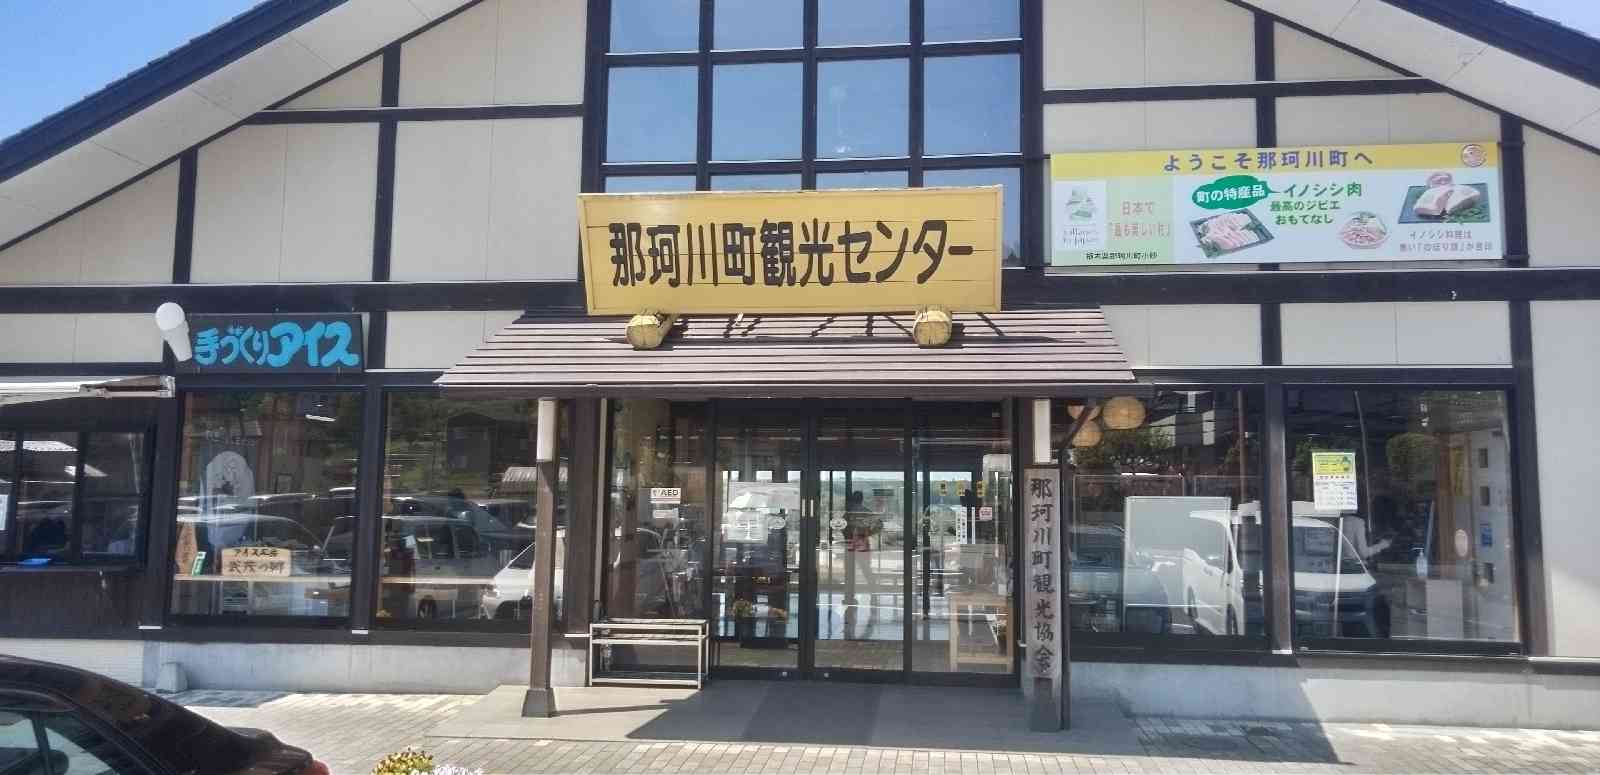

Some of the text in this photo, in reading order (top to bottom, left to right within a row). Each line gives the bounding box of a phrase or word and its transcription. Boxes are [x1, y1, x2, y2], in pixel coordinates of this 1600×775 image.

[1164, 150, 1373, 171] ようこそ那珂川町へ
[1196, 184, 1265, 203] 町の特産品
[1283, 182, 1362, 197] イノシシ肉
[1122, 201, 1156, 216] 日本で
[1270, 200, 1341, 212] 最高のジビエ
[1275, 214, 1333, 225] おもてなし
[608, 218, 973, 288] 那珂川町観光センター
[194, 320, 360, 368] 手づくりアイス
[1030, 477, 1055, 674] 那珂川町観光協会
